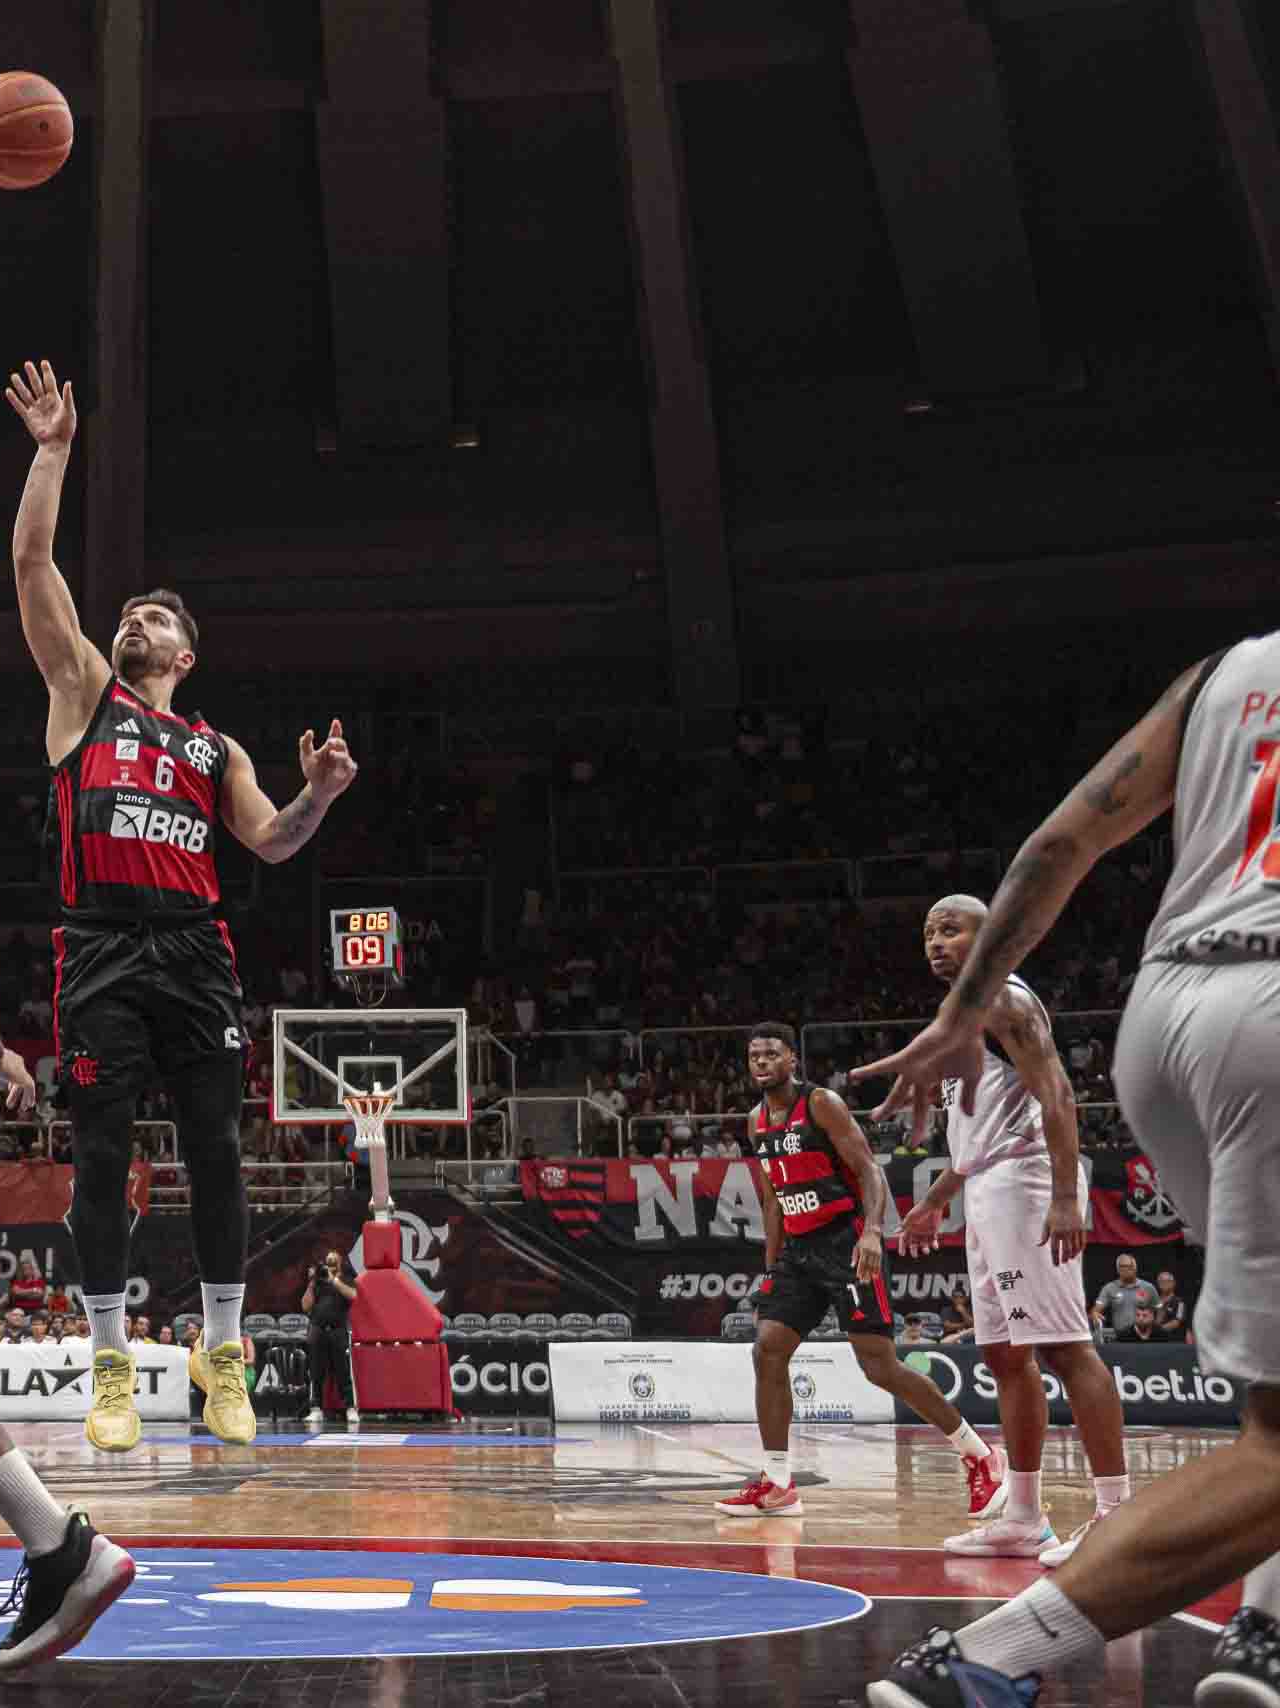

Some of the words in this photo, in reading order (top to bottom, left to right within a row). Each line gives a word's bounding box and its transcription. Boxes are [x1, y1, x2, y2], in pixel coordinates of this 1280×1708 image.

[155, 755, 176, 792] 6
[116, 792, 152, 806] banco
[145, 808, 208, 854] BRB
[346, 936, 380, 965] 09
[449, 1354, 550, 1393] ÓCIO
